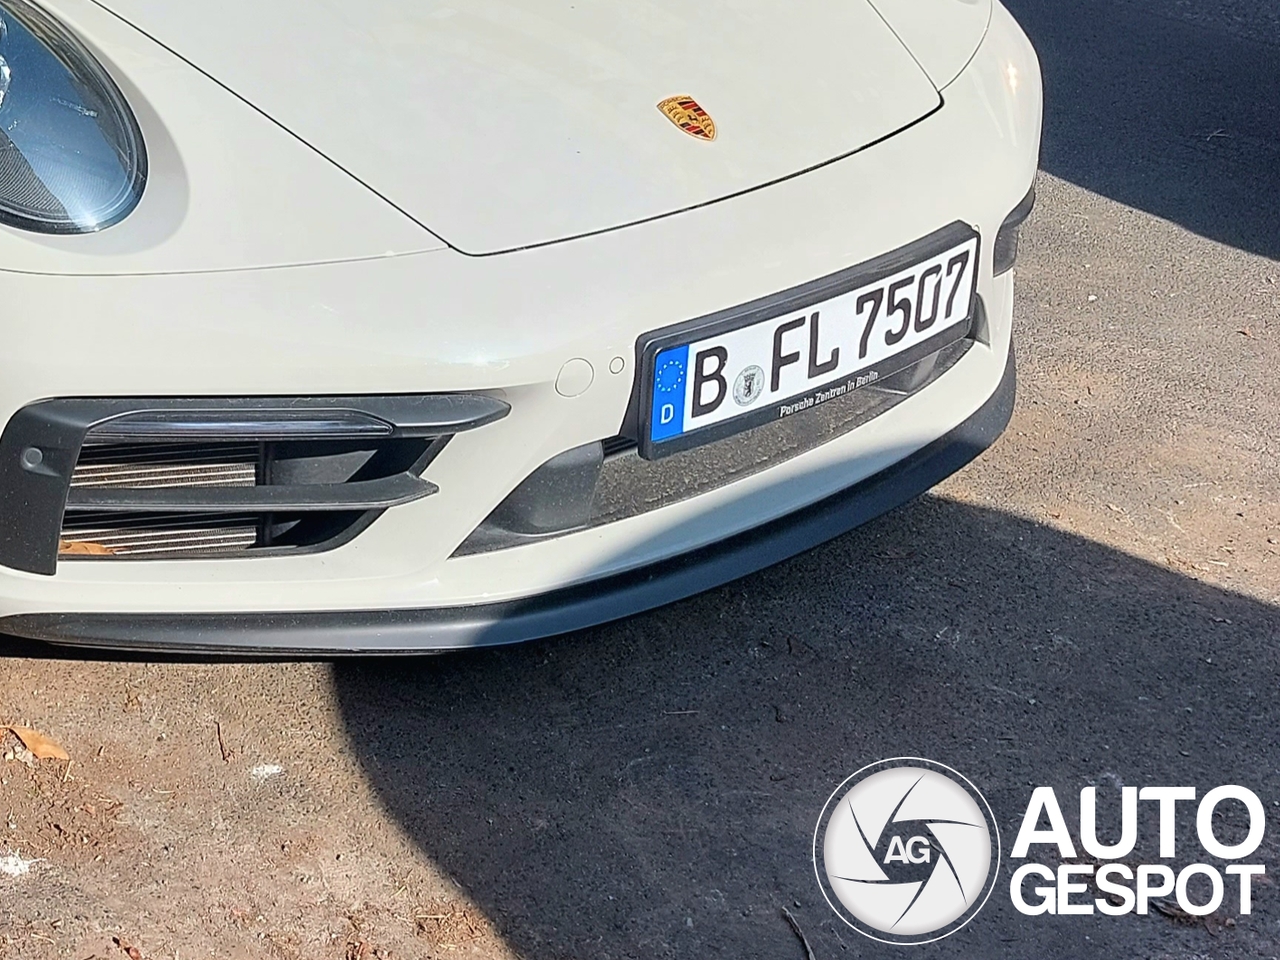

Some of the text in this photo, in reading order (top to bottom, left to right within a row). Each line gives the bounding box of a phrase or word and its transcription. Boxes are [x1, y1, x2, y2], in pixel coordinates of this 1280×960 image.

[661, 403, 674, 425] D
[691, 346, 728, 418] B
[770, 312, 839, 392] FL
[856, 249, 969, 360] 7507
[780, 396, 814, 418] Porsche
[847, 380, 855, 392] in
[856, 371, 879, 389] Berlin
